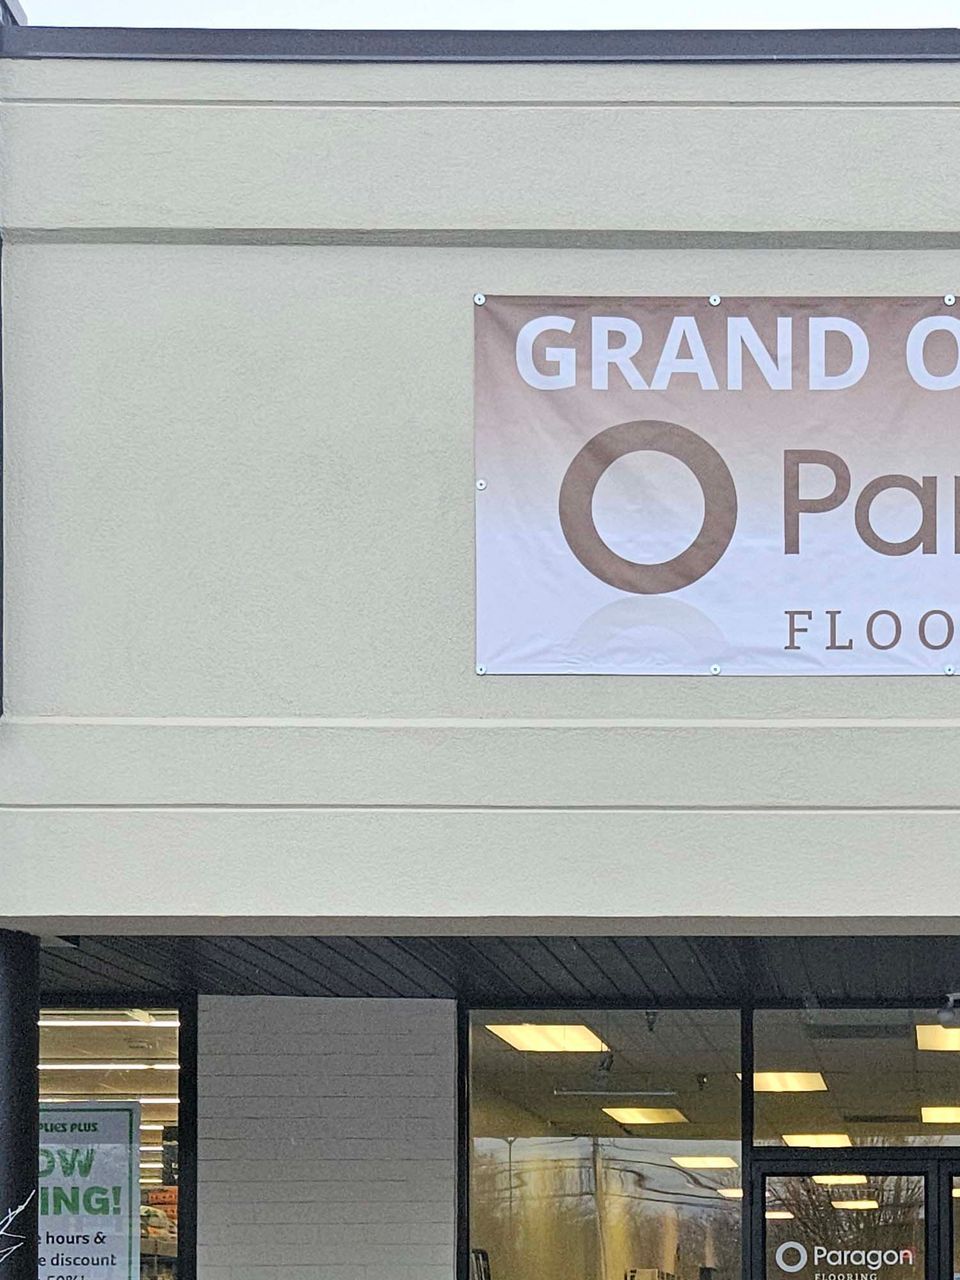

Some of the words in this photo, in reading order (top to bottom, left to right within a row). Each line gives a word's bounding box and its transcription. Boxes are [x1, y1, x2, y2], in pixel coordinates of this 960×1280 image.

[513, 315, 870, 391] GRAND
[70, 1122, 98, 1133] PLUS
[40, 1186, 122, 1216] ING!
[46, 1231, 90, 1245] hours
[94, 1231, 107, 1245] &
[50, 1253, 117, 1267] discount
[813, 1246, 913, 1270] Paragon
